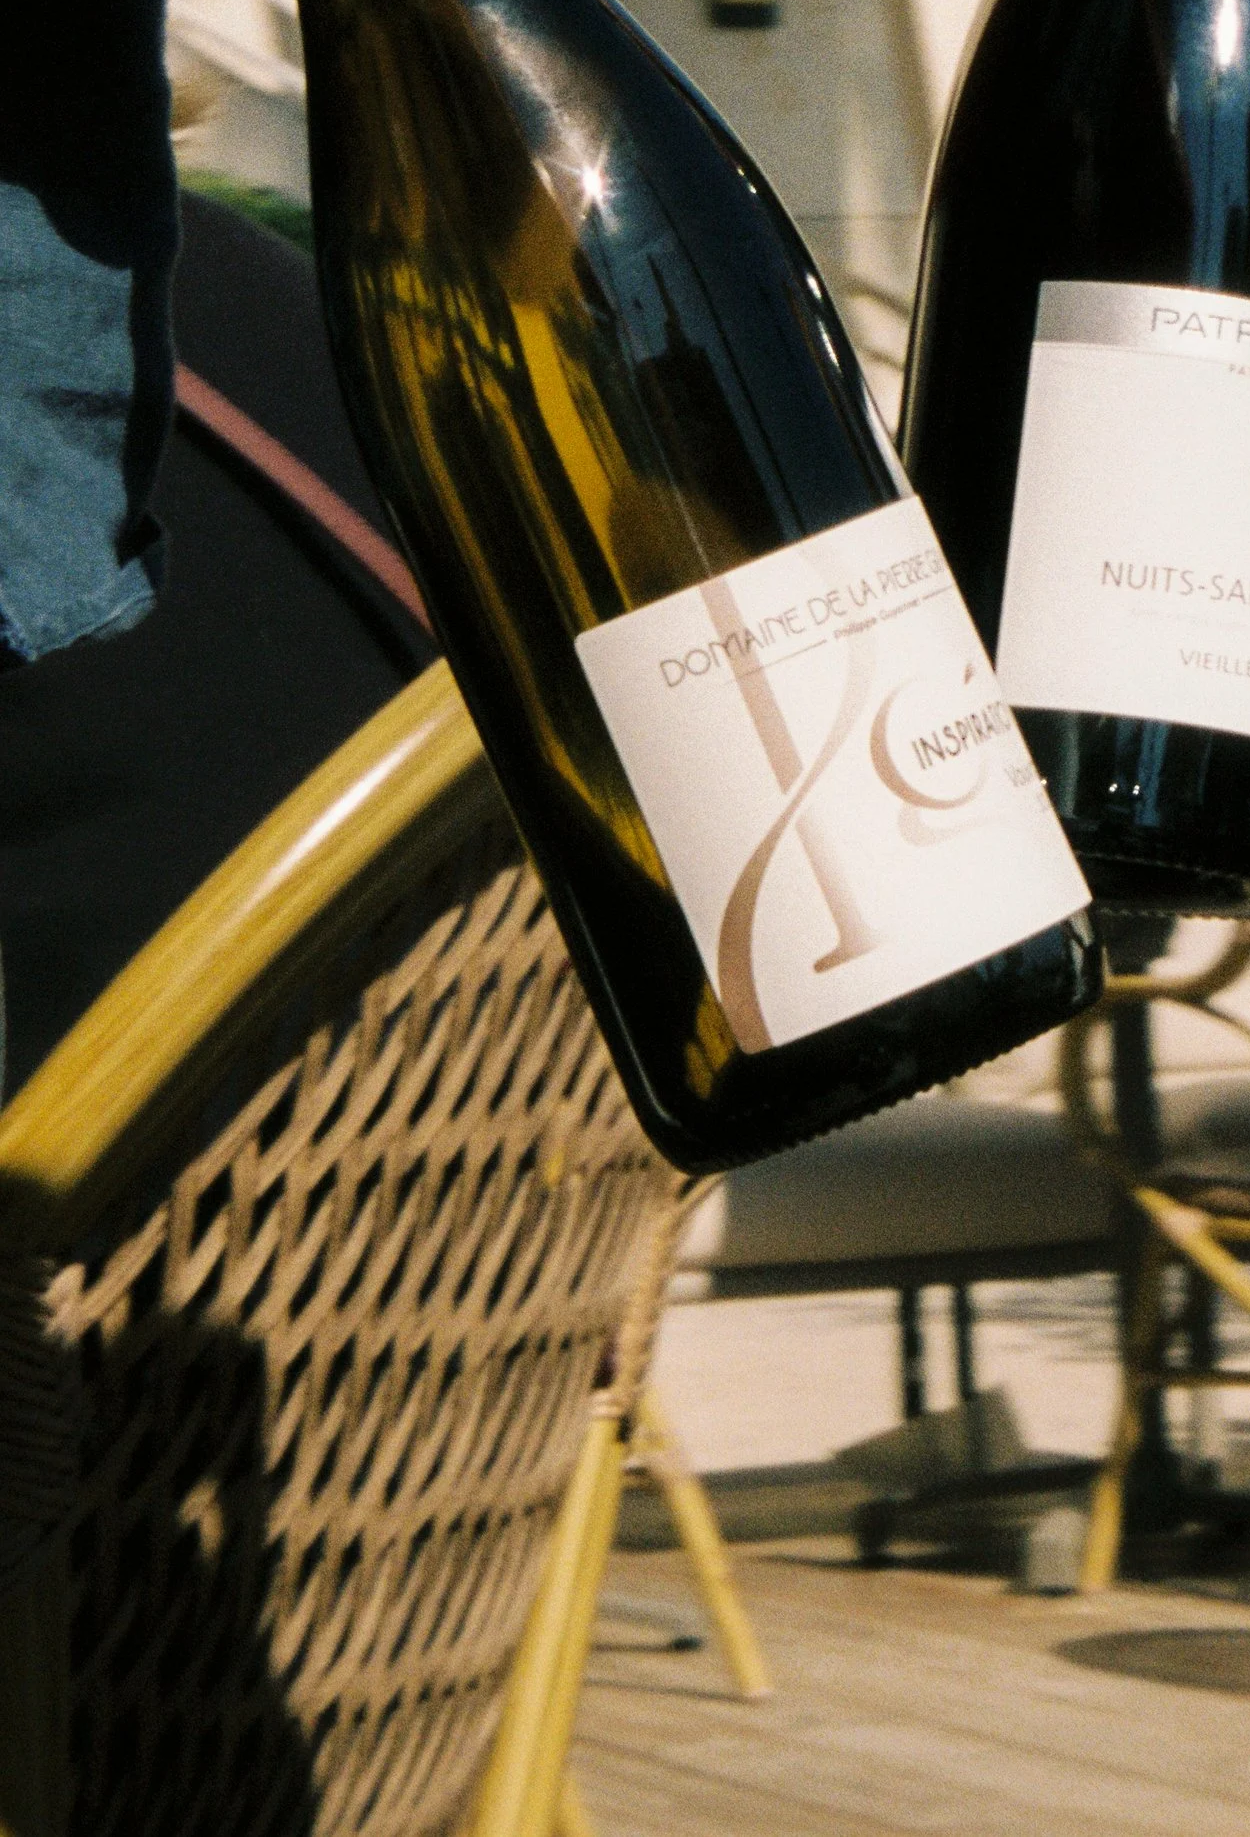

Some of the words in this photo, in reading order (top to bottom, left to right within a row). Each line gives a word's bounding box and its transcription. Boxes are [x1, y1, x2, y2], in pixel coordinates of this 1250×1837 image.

[659, 605, 806, 687] DOMAINE
[807, 589, 847, 626] DE
[847, 578, 879, 608] LA
